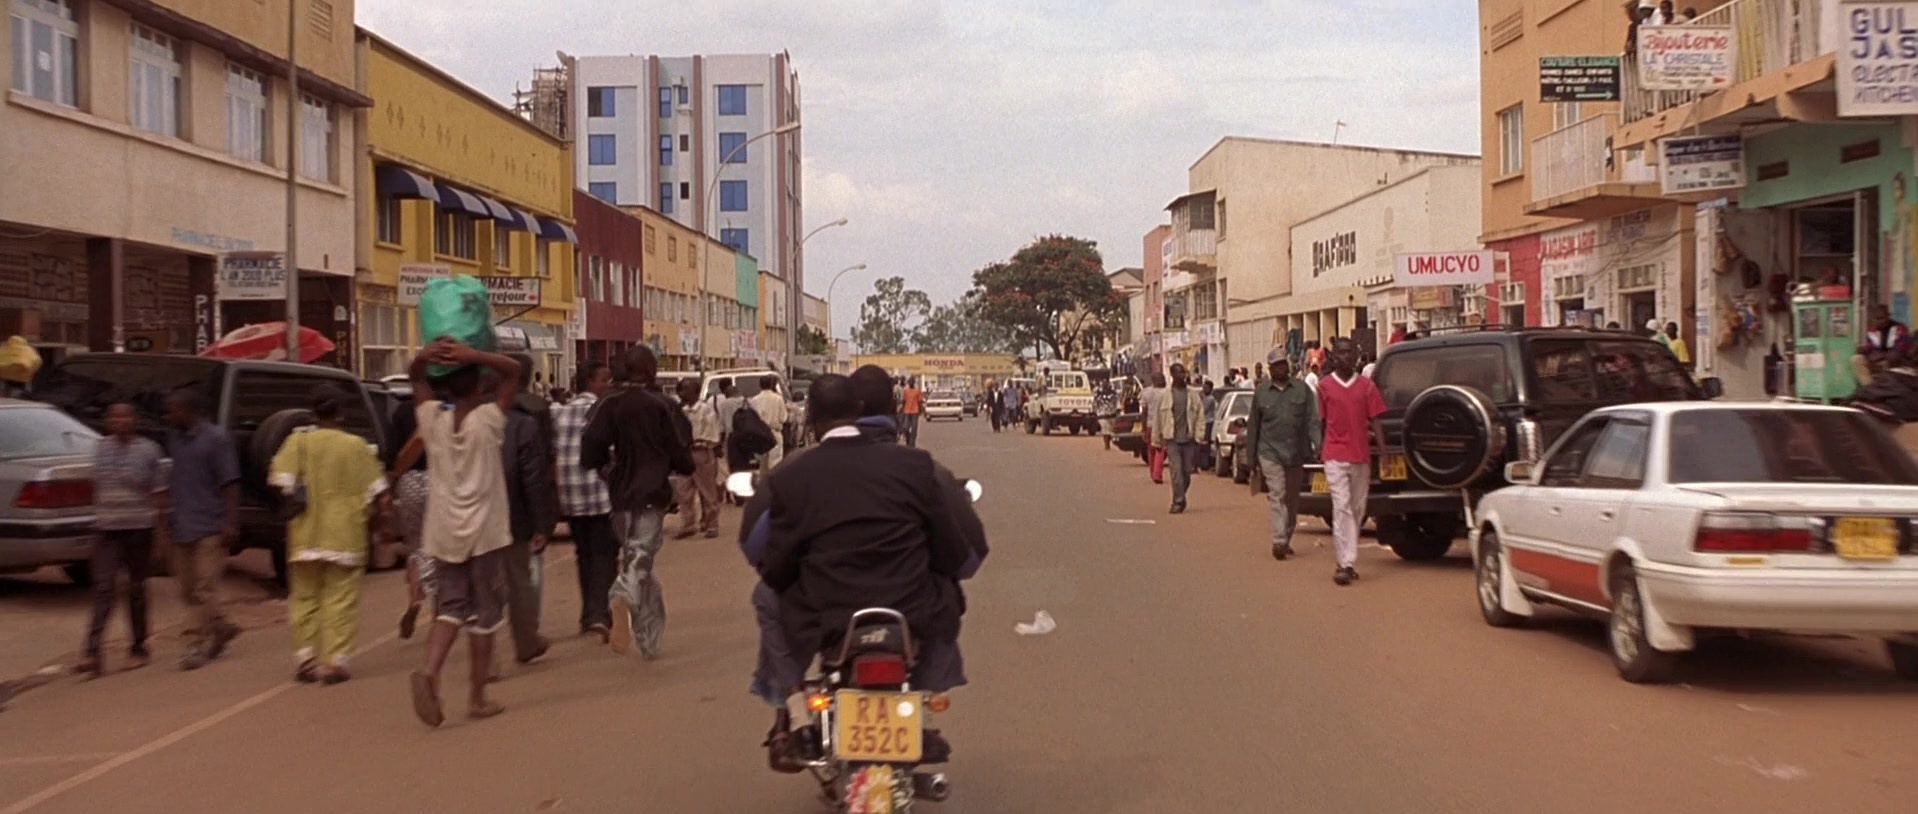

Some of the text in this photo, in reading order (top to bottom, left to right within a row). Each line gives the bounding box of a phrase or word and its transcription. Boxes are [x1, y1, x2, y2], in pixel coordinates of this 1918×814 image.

[1642, 31, 1728, 55] Bijouterie
[1850, 35, 1918, 59] JAS
[224, 255, 282, 269] PHARMACIE
[1408, 255, 1480, 274] UMUCYO
[400, 275, 429, 284] PHARM
[406, 286, 428, 296] EXC
[924, 359, 964, 367] HONDA
[848, 726, 908, 754] 352C
